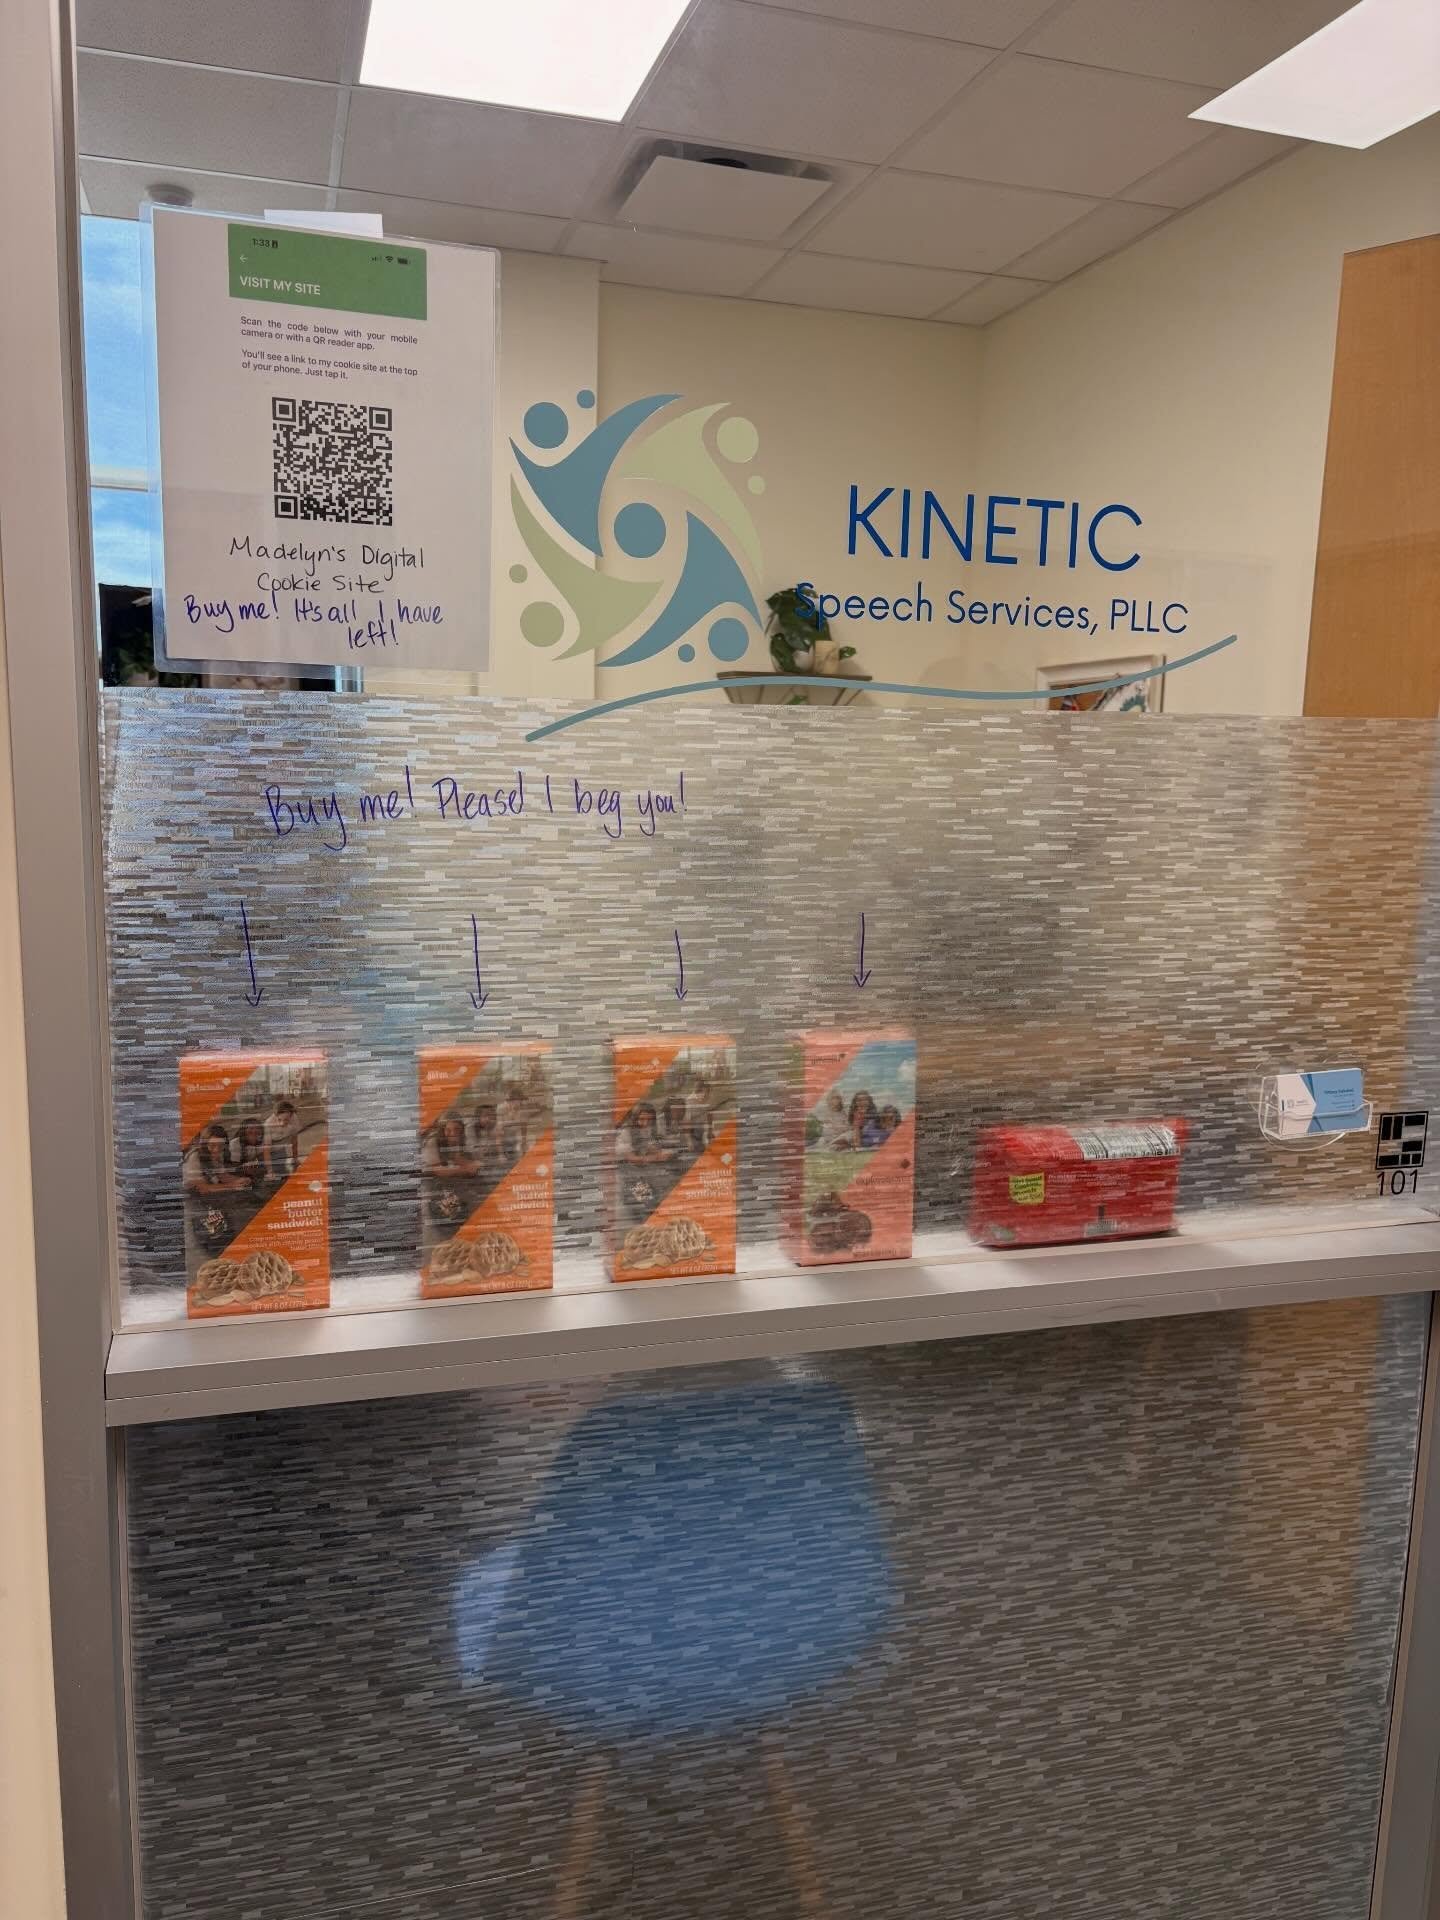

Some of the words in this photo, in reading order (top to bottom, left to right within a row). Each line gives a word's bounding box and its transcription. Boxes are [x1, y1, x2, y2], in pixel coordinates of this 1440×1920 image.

[239, 275, 270, 289] VISIT
[273, 279, 292, 292] MY
[295, 282, 321, 296] SITE
[241, 315, 262, 326] Scan
[268, 319, 282, 329] the
[287, 323, 308, 331] code
[314, 324, 338, 335] below
[344, 328, 362, 338] with
[367, 332, 385, 340] your
[391, 334, 418, 344] mobile
[241, 329, 273, 339] camera
[286, 334, 303, 343] with
[313, 335, 326, 345] QR
[327, 338, 355, 348] reader
[357, 342, 375, 351] app.
[241, 361, 250, 369] of
[253, 363, 272, 371] your
[274, 365, 303, 375] phone.
[305, 367, 323, 377] Just
[325, 369, 338, 380] tap
[340, 370, 348, 380] it.
[242, 348, 265, 360] You'll
[267, 353, 282, 361] see
[291, 354, 306, 364] link
[308, 356, 317, 365] to
[318, 360, 331, 368] my
[334, 360, 361, 370] cookie
[362, 362, 377, 372] site
[379, 365, 388, 373] at
[389, 365, 402, 374] the
[404, 367, 418, 377] top
[848, 484, 1143, 572] KINETIC
[229, 535, 346, 577] Madelyn's
[362, 544, 424, 581] Digital
[257, 572, 321, 592] Cookie
[333, 574, 384, 594] Site
[184, 594, 235, 633] Buy
[239, 590, 280, 620] me!
[295, 597, 323, 622] It's
[328, 599, 357, 624] all
[378, 600, 385, 624] I
[397, 598, 444, 625] have
[794, 581, 932, 632] Speech
[947, 590, 1099, 635] Services,
[1110, 598, 1189, 634] PLLC
[348, 619, 398, 650] left!
[265, 785, 348, 851] Buy
[360, 765, 419, 820] me!
[545, 775, 554, 814] I
[574, 778, 623, 838] beg
[638, 771, 688, 837] you!
[1376, 1169, 1419, 1196] 101
[283, 1198, 323, 1211] peanut
[288, 1207, 323, 1219] butter
[267, 1217, 323, 1231] sandwich
